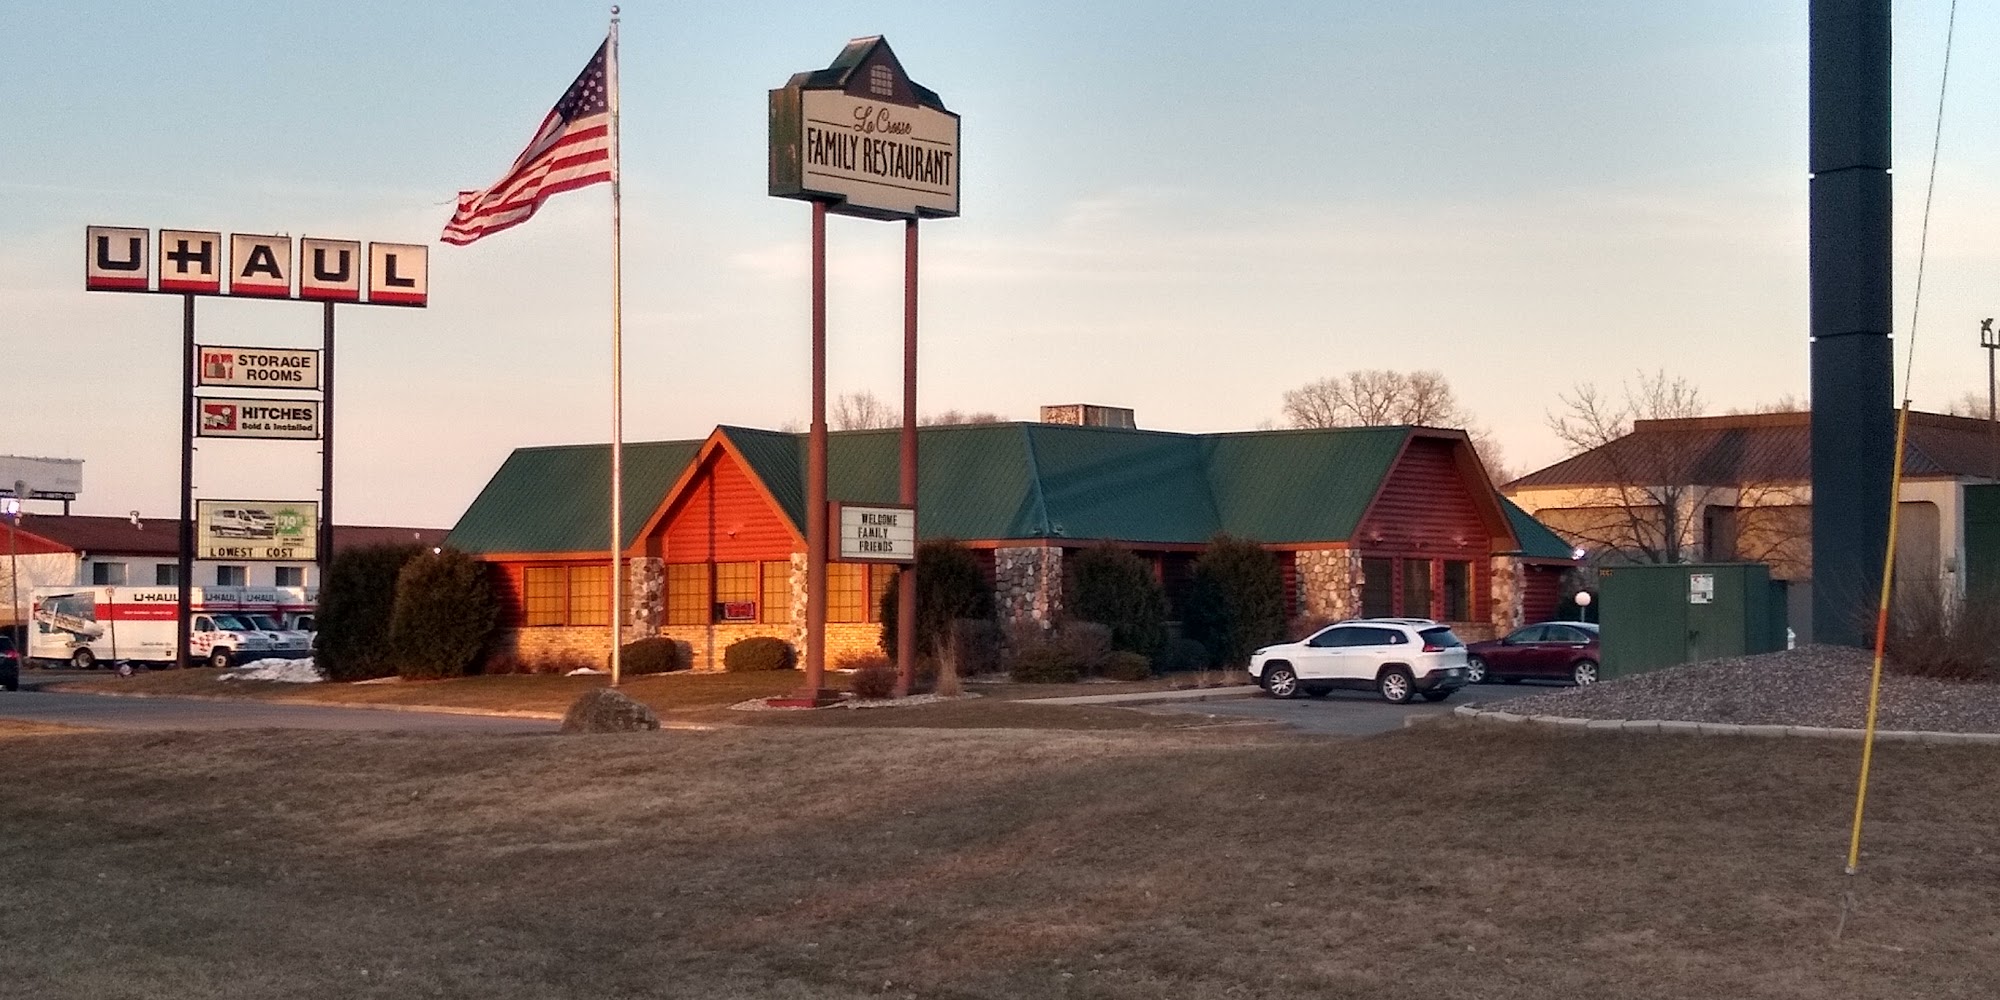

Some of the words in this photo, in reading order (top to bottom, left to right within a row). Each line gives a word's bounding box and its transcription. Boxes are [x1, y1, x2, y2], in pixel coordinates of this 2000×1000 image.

[853, 106, 875, 135] La
[876, 107, 913, 136] Crosse
[807, 127, 859, 172] FAMILY
[863, 137, 953, 186] RESTAURANT
[238, 354, 311, 369] STORAGE
[246, 369, 303, 382] ROOMS
[242, 406, 313, 421] HITCHES
[242, 422, 262, 430] Sold
[273, 423, 313, 431] Installed
[861, 513, 898, 526] WELCOME
[857, 526, 889, 538] FAMILY
[209, 546, 254, 558] LOWEST
[266, 548, 294, 558] COST
[859, 540, 893, 552] FRIENDS
